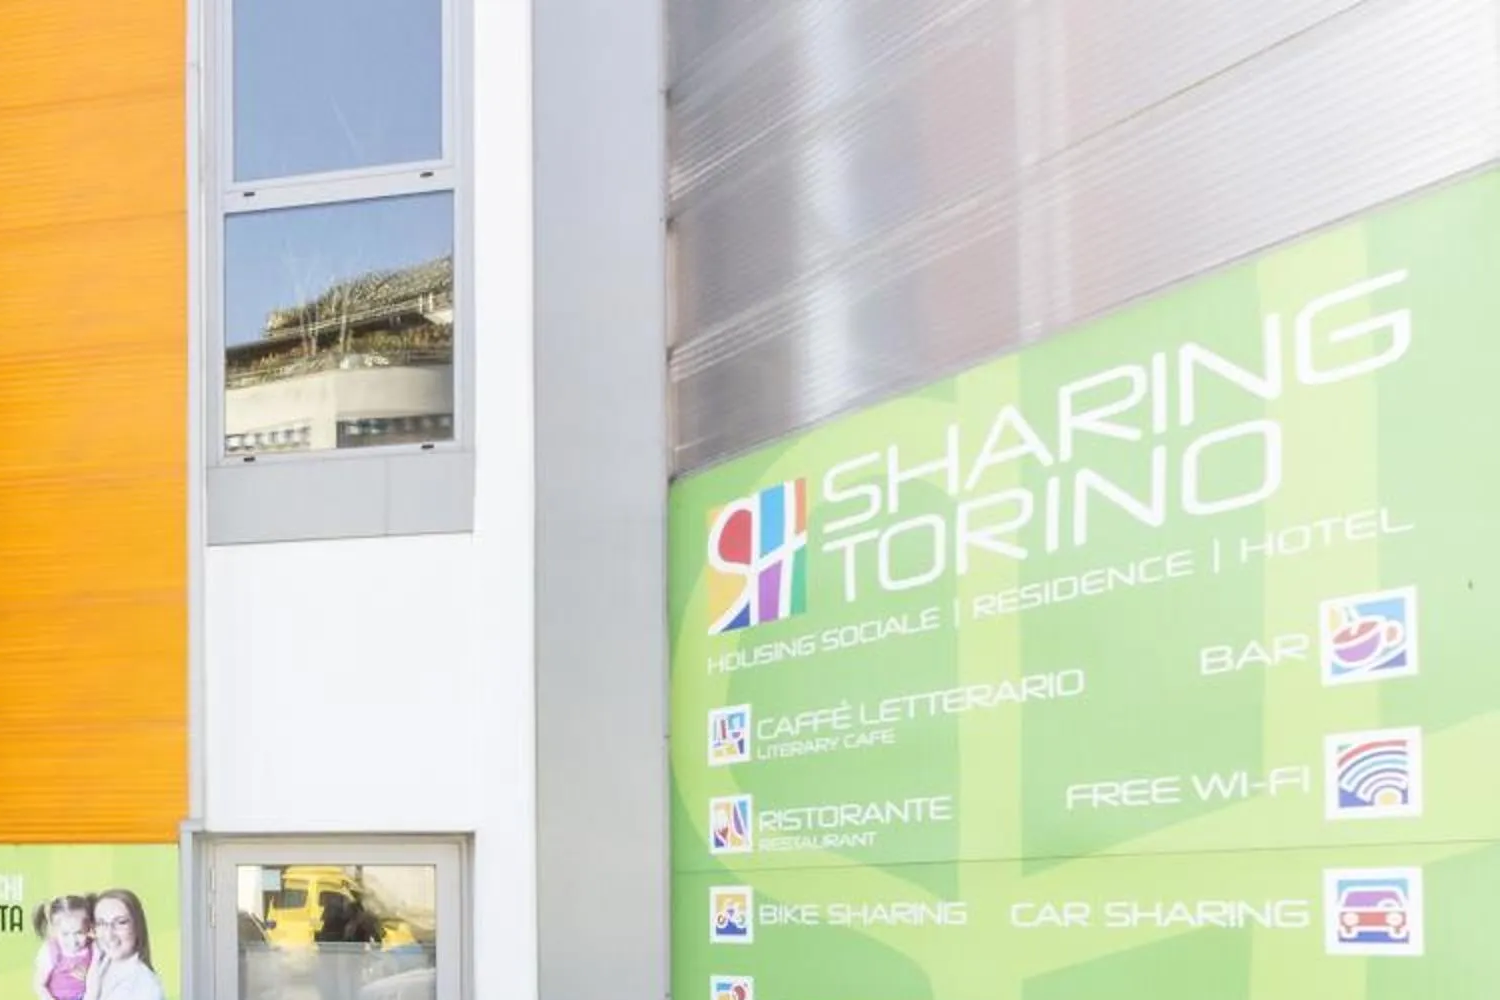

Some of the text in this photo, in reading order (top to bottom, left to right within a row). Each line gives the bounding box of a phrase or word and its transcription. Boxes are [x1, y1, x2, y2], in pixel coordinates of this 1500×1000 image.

[822, 268, 1411, 534] SHARING
[822, 419, 1282, 602] TORINO
[707, 507, 1415, 676] HOUSING SOCIALE RESIDENCE HOTEL
[1200, 632, 1310, 676] BAR
[860, 668, 1085, 726] LETTERARIO
[757, 736, 841, 760] LITERARY
[1065, 765, 1311, 810] FREE WI-FI
[758, 795, 952, 833] RISTORANTE
[758, 831, 877, 851] RESTAURANT
[758, 901, 968, 926] BIKE SHARING
[1009, 899, 1311, 929] CAR SHARING
